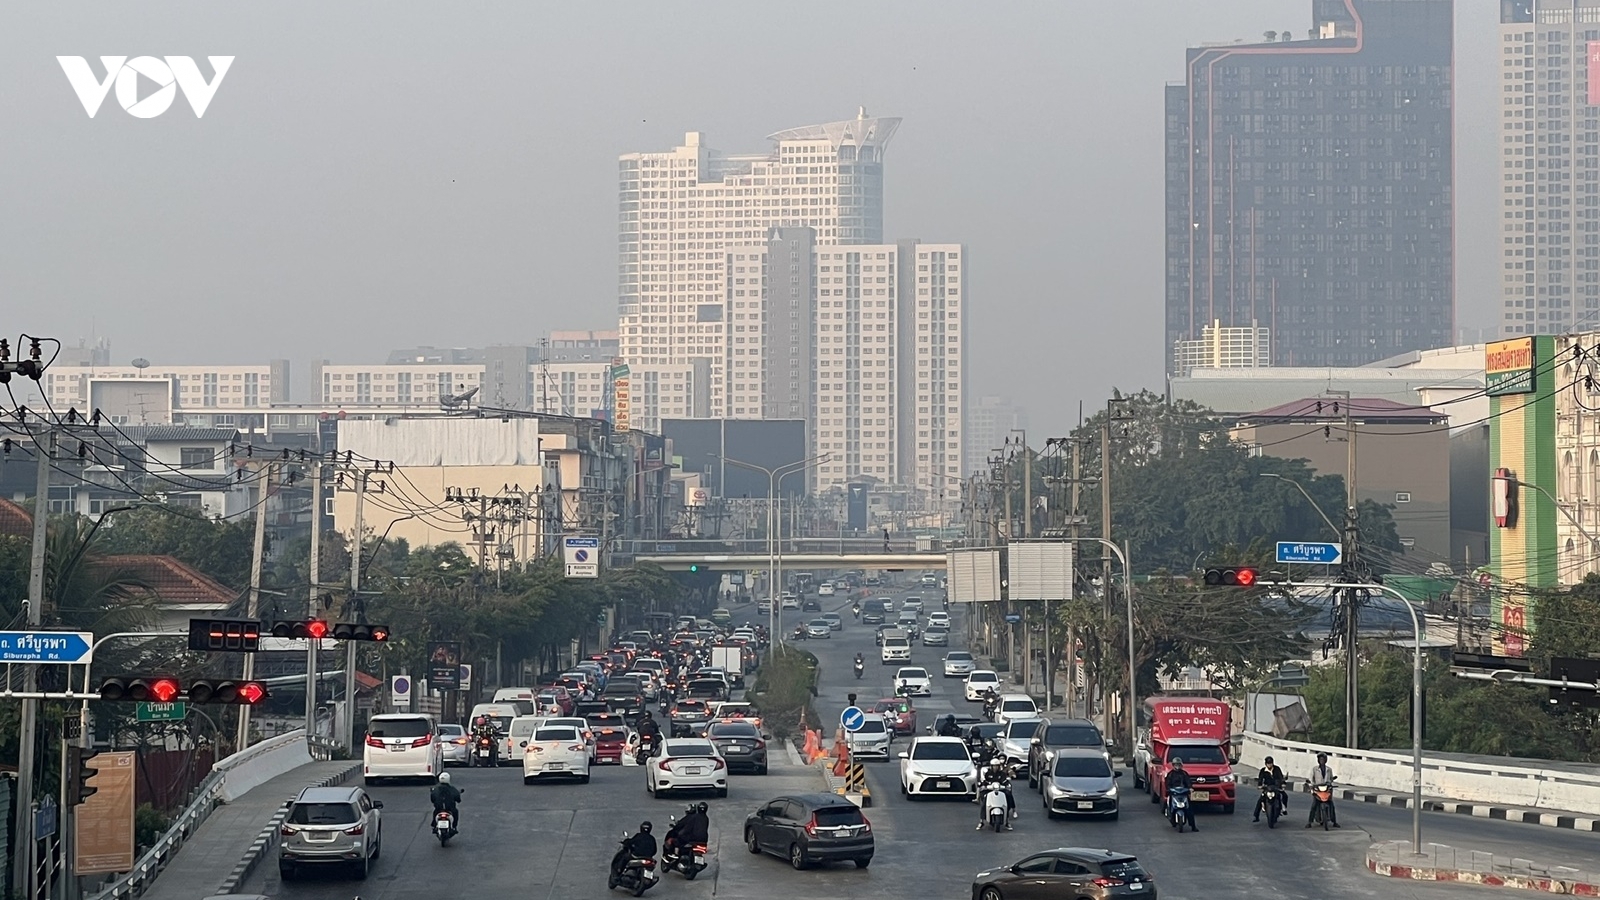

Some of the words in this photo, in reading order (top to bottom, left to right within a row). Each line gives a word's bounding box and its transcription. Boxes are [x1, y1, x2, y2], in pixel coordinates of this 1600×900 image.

[1294, 545, 1326, 556] ศรีบูรพา
[17, 634, 67, 652] ศรีบูรพา
[3, 652, 41, 660] Siburapha
[48, 652, 60, 660] Rd.
